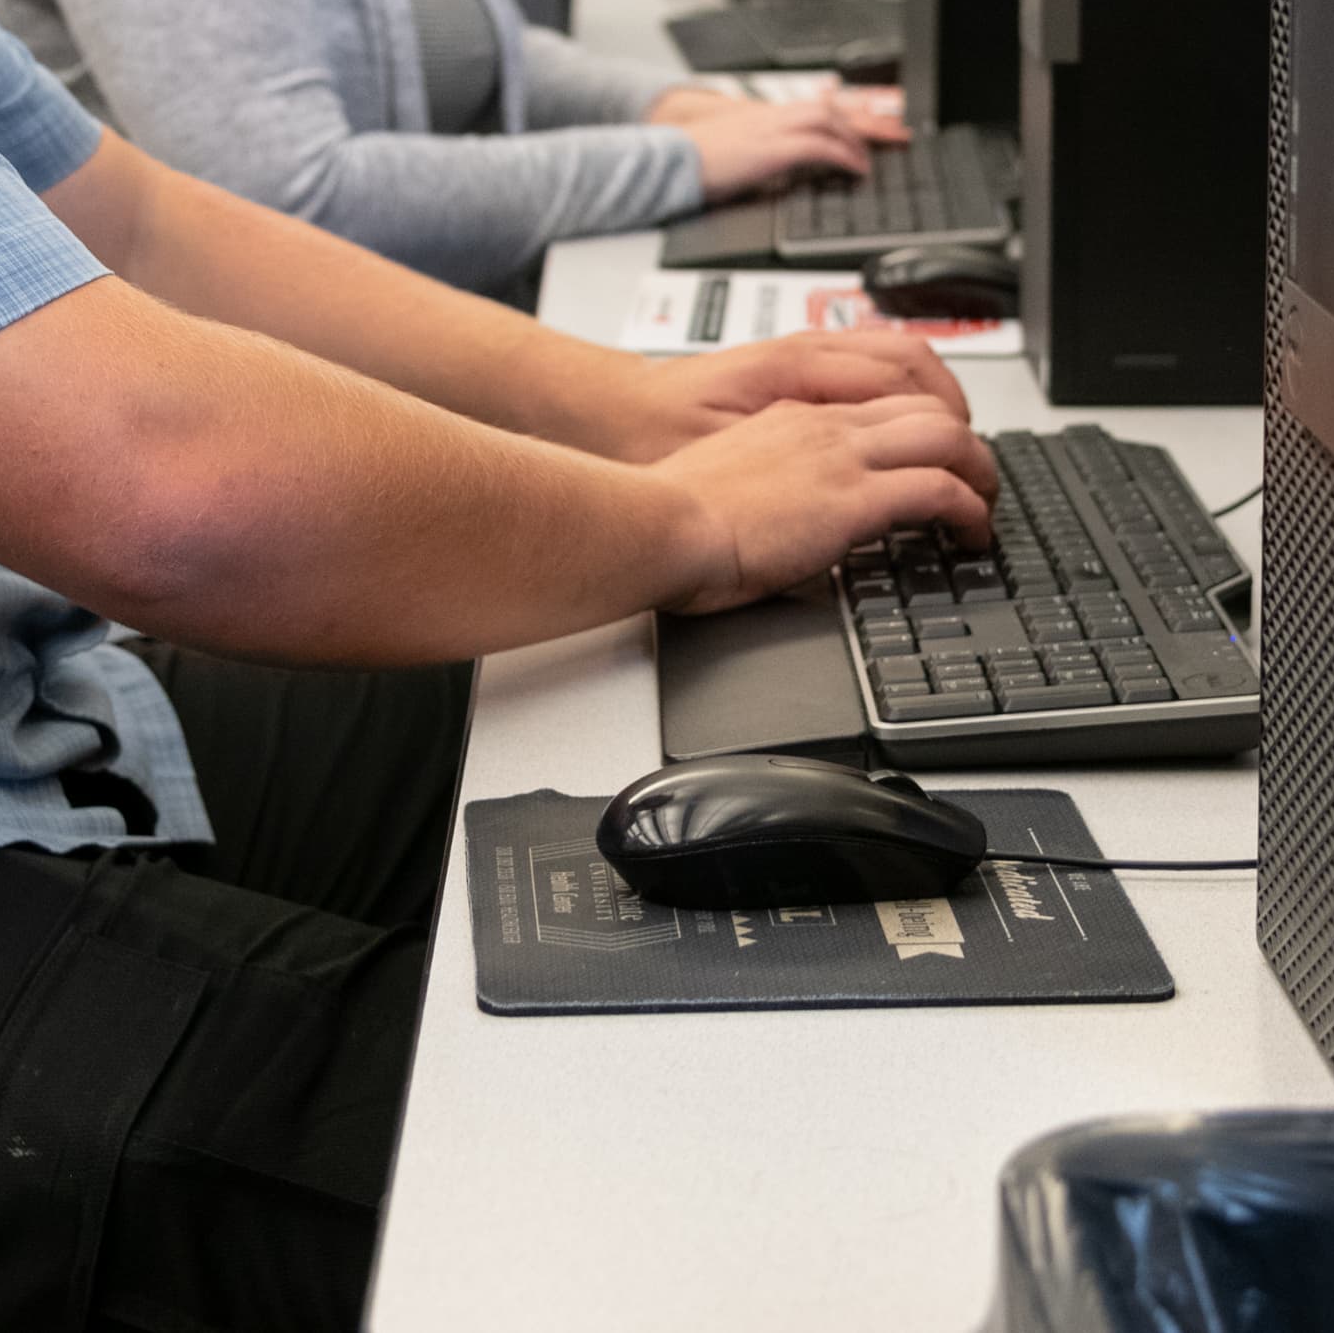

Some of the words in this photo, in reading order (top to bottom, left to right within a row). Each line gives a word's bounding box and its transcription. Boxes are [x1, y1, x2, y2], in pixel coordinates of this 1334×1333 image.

[550, 871, 579, 892] Health
[588, 862, 613, 921] UNIVERSITY
[553, 892, 579, 914] Center
[617, 893, 644, 921] State
[894, 900, 935, 938] ll-being
